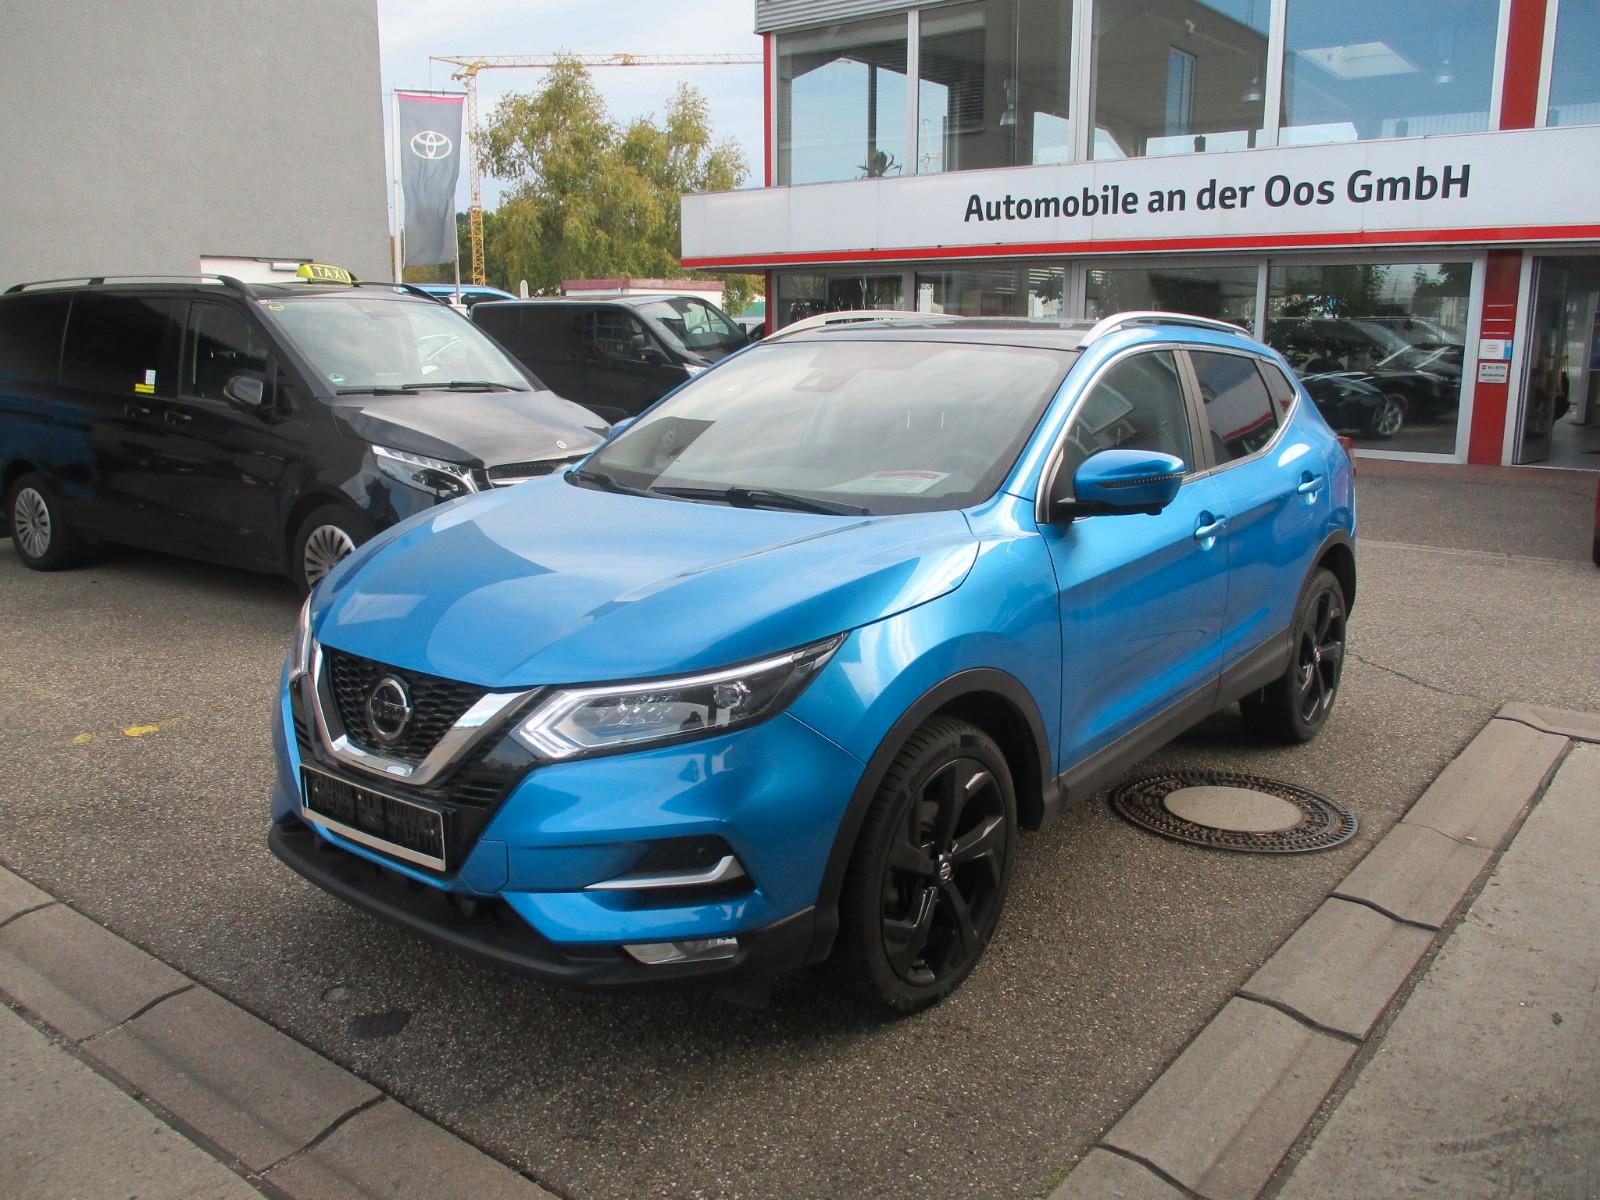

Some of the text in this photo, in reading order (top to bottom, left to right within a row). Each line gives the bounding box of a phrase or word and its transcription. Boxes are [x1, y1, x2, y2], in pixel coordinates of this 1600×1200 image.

[963, 163, 1471, 223] Automobile an der Oos GmbH
[313, 266, 347, 281] TAXI
